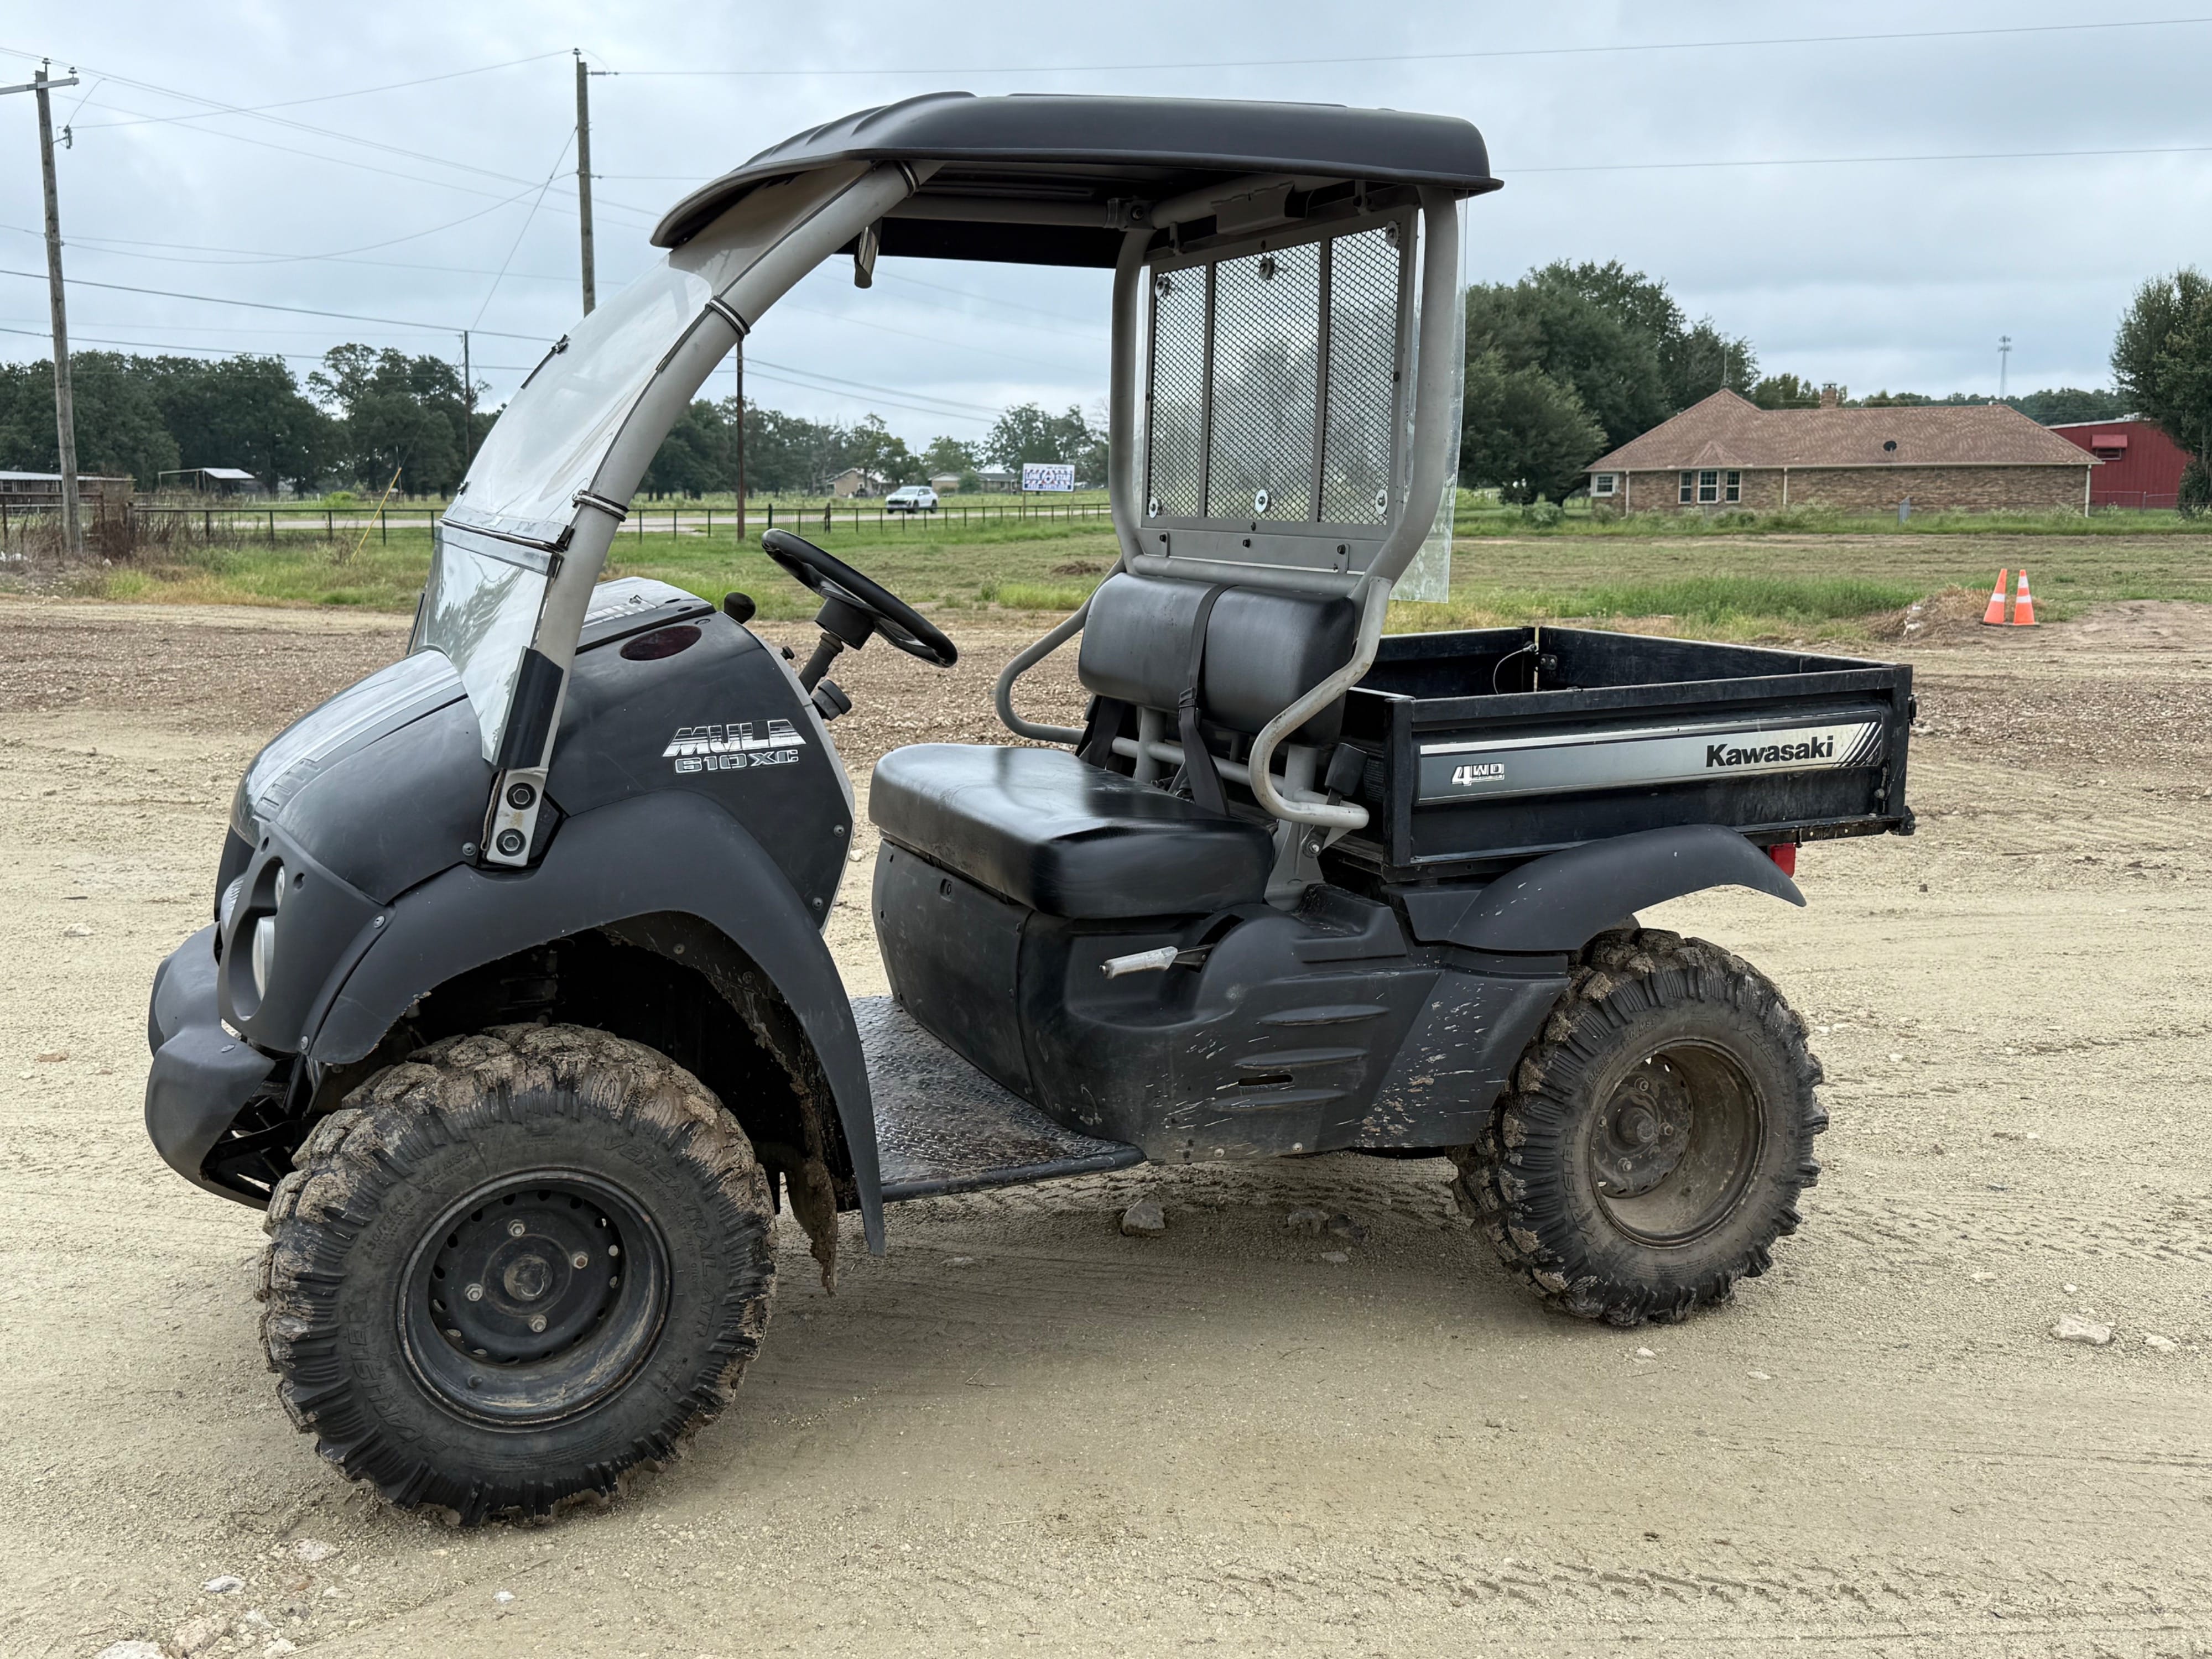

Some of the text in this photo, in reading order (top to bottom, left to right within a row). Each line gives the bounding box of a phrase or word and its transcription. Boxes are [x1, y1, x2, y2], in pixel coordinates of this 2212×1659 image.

[674, 749, 799, 774] 610XC
[1706, 735, 1834, 768] Kawasaki
[1451, 763, 1505, 786] 4WD
[603, 1136, 686, 1199] VERSA
[683, 1198, 717, 1277] TRAIL
[694, 1281, 716, 1337] ATR
